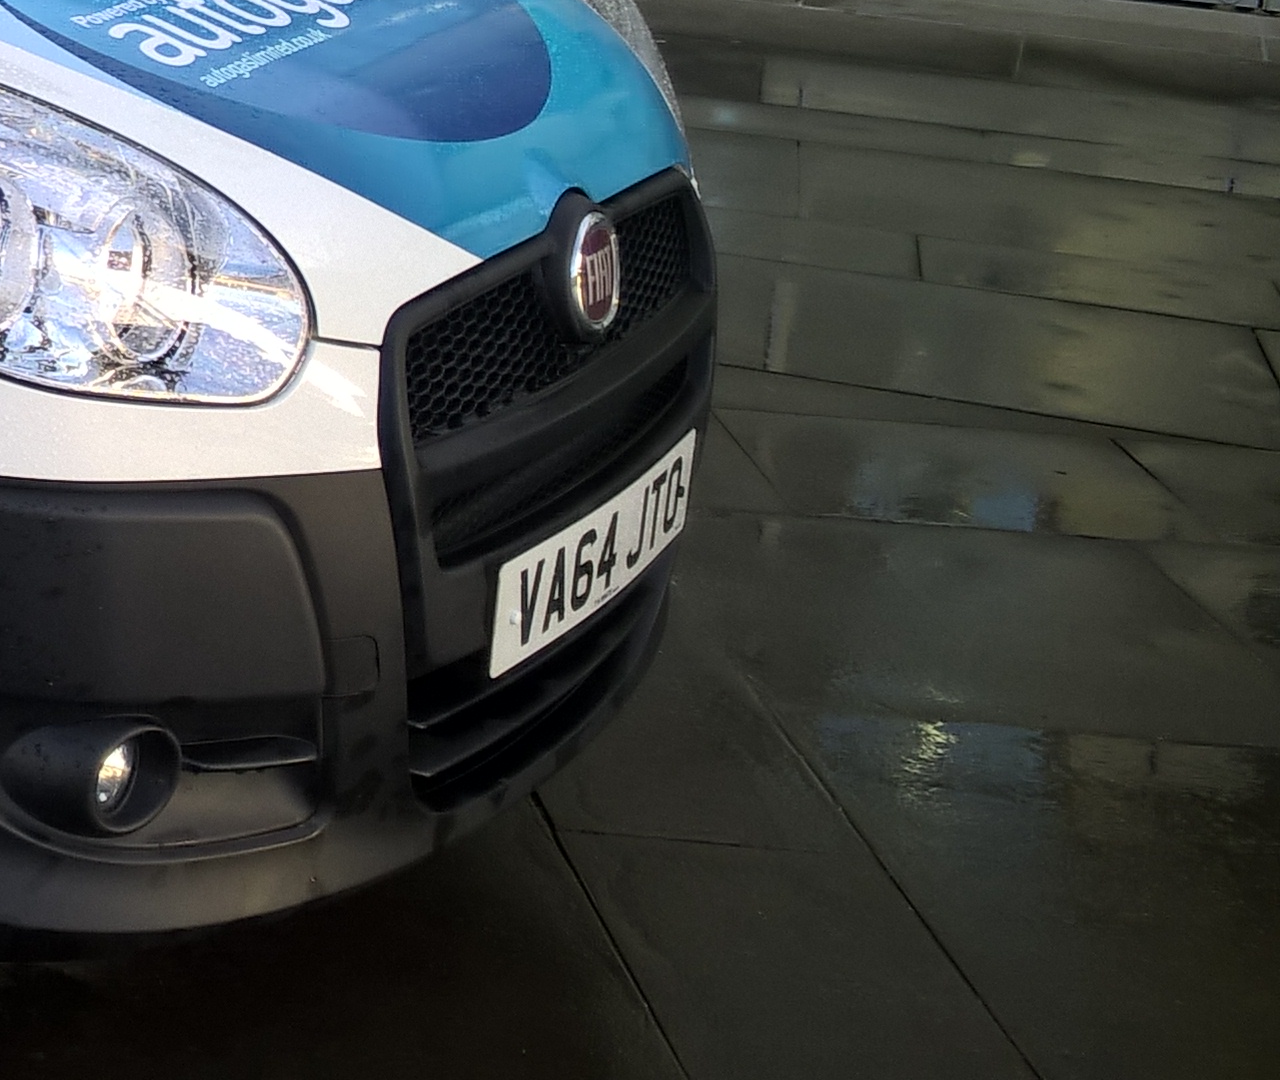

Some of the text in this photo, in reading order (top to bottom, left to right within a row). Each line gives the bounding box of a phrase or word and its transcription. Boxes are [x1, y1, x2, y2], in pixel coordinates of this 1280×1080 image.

[200, 27, 332, 88] autogaslimited.co.uk
[585, 244, 612, 306] FIAT
[520, 456, 683, 646] VA64 JTO
